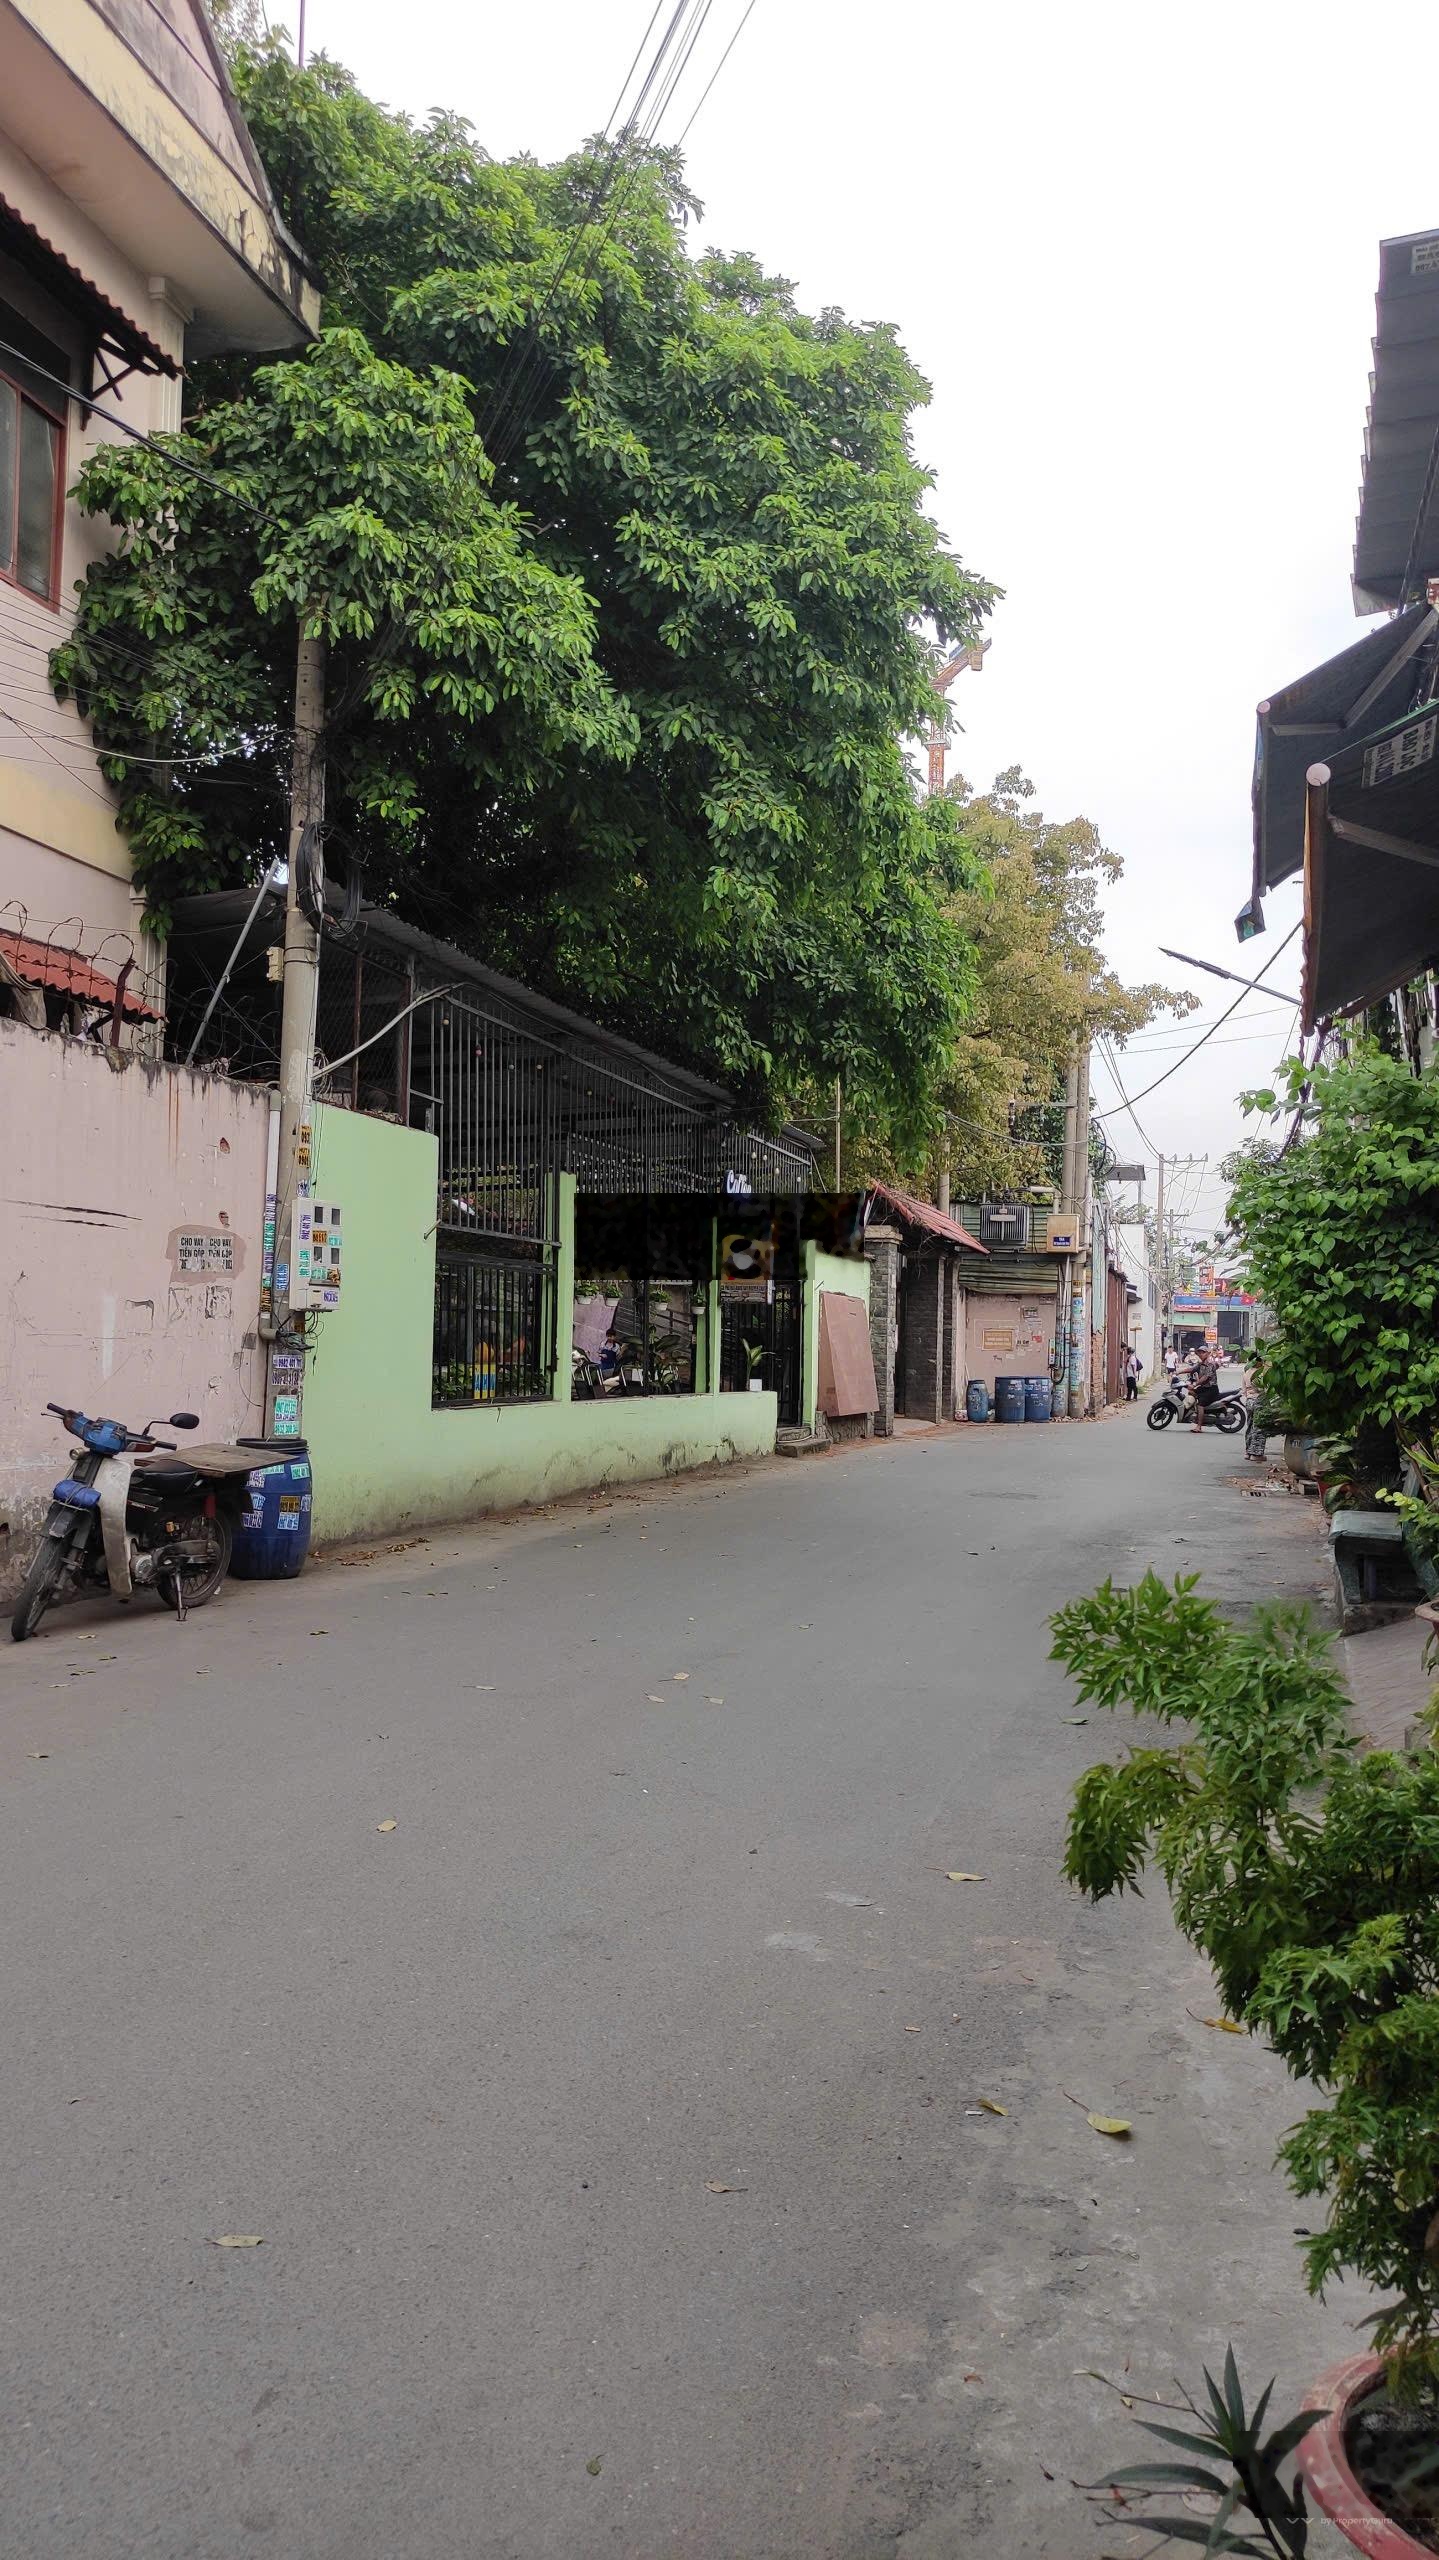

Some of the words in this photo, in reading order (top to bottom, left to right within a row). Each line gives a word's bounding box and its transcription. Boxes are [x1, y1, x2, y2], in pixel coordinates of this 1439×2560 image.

[180, 1237, 193, 1246] CHO
[193, 1237, 204, 1246] VAY
[221, 1238, 232, 1247] VAY
